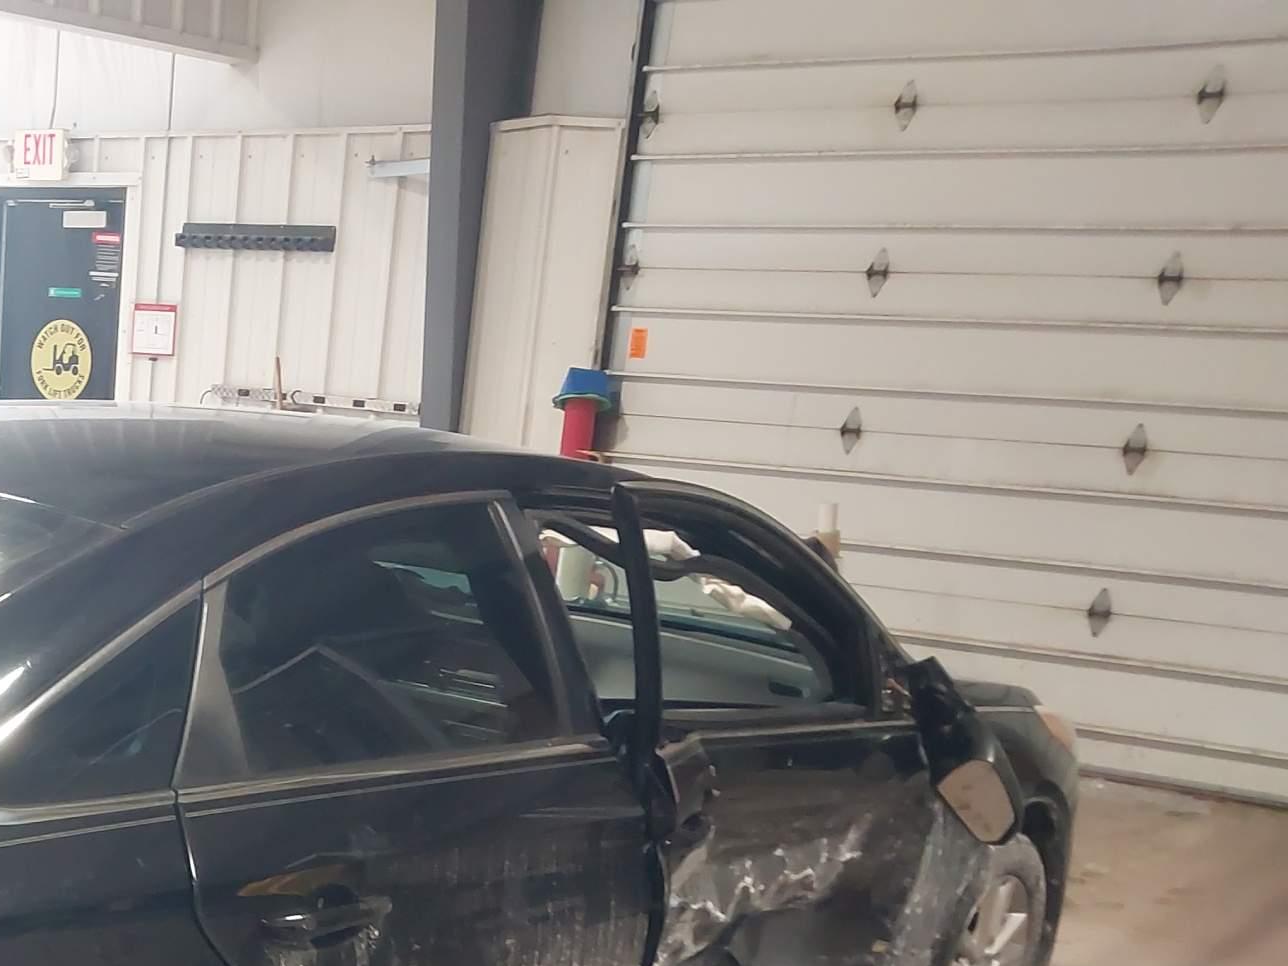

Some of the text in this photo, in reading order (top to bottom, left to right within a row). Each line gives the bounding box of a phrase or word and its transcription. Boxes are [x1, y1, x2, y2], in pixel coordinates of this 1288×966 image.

[24, 134, 56, 165] EXIT
[37, 323, 86, 352] WATCH OUT FOR
